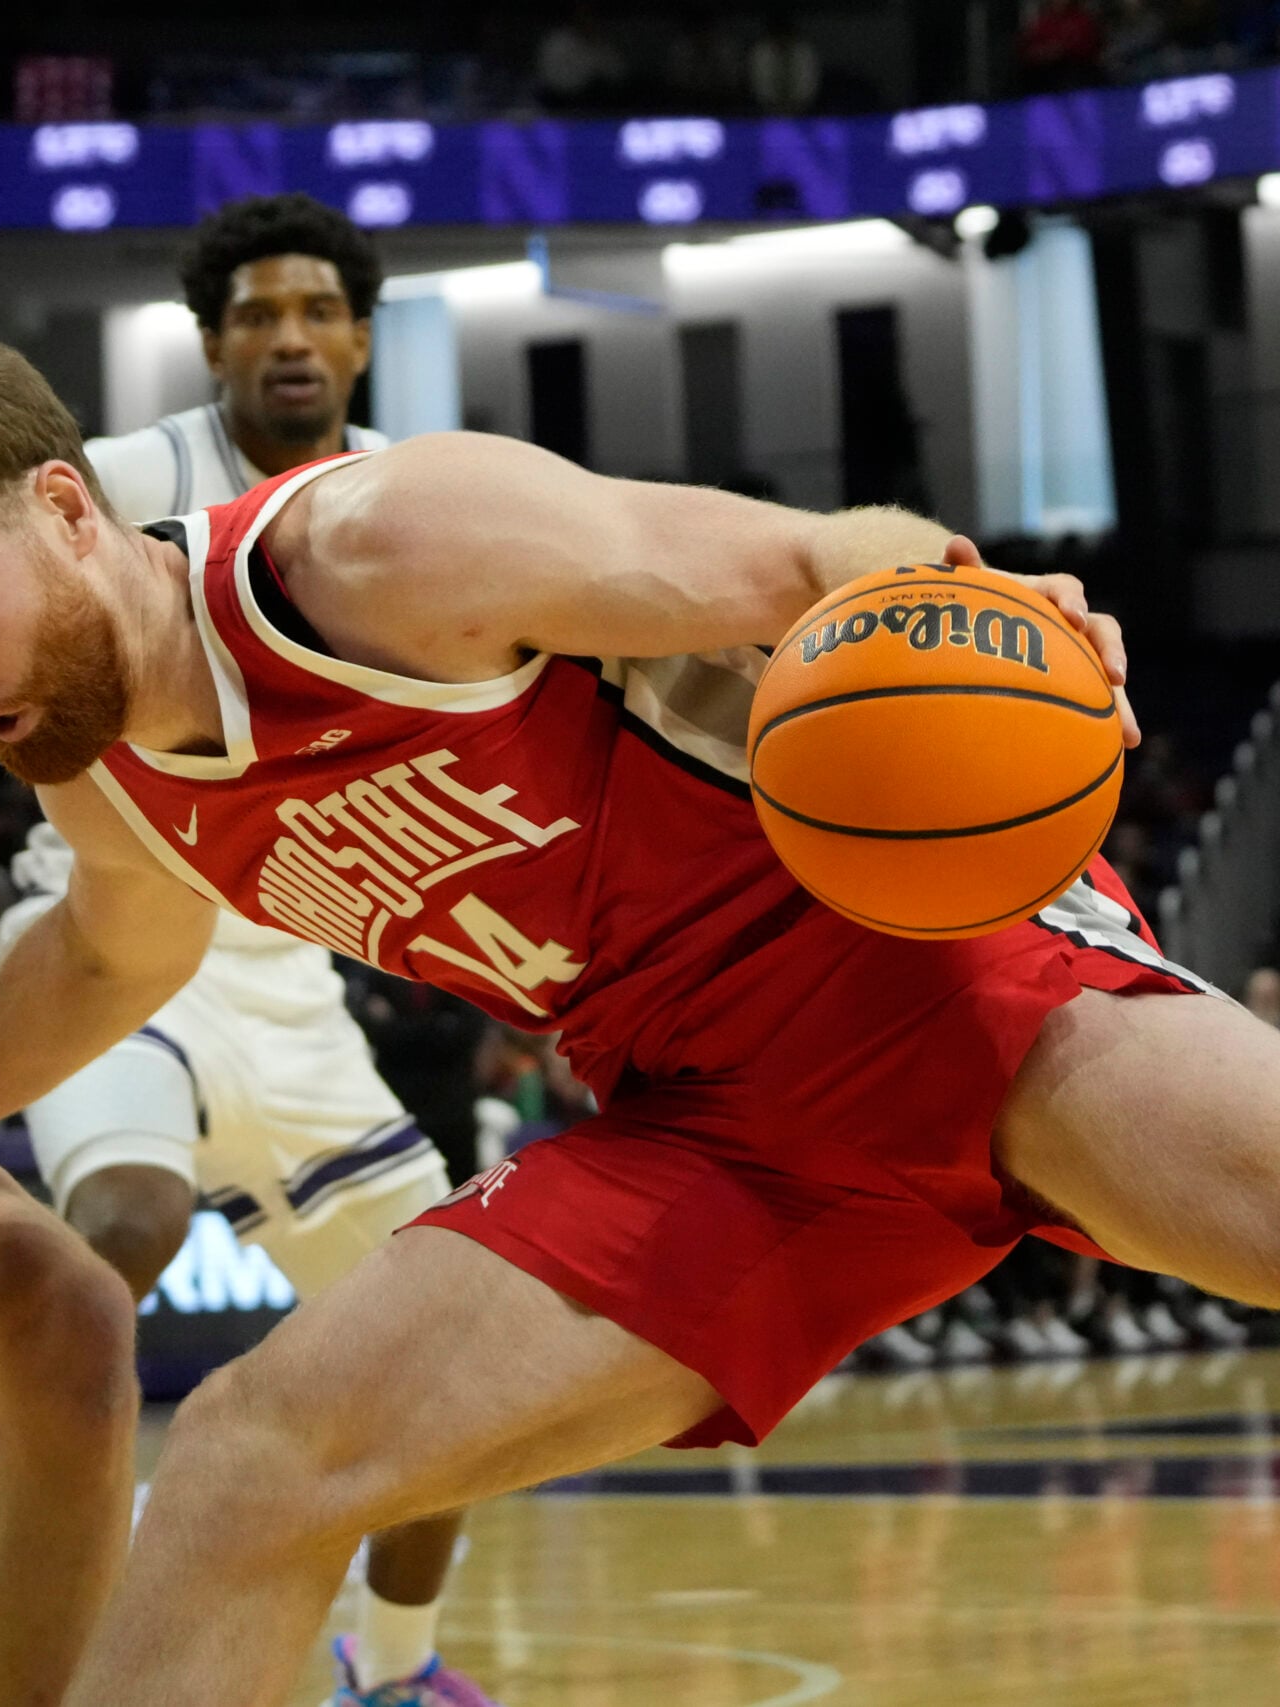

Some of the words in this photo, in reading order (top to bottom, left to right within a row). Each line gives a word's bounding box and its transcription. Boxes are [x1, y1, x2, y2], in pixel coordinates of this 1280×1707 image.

[800, 602, 1049, 675] Wilson
[274, 748, 582, 919] STATE
[406, 891, 588, 1018] 14
